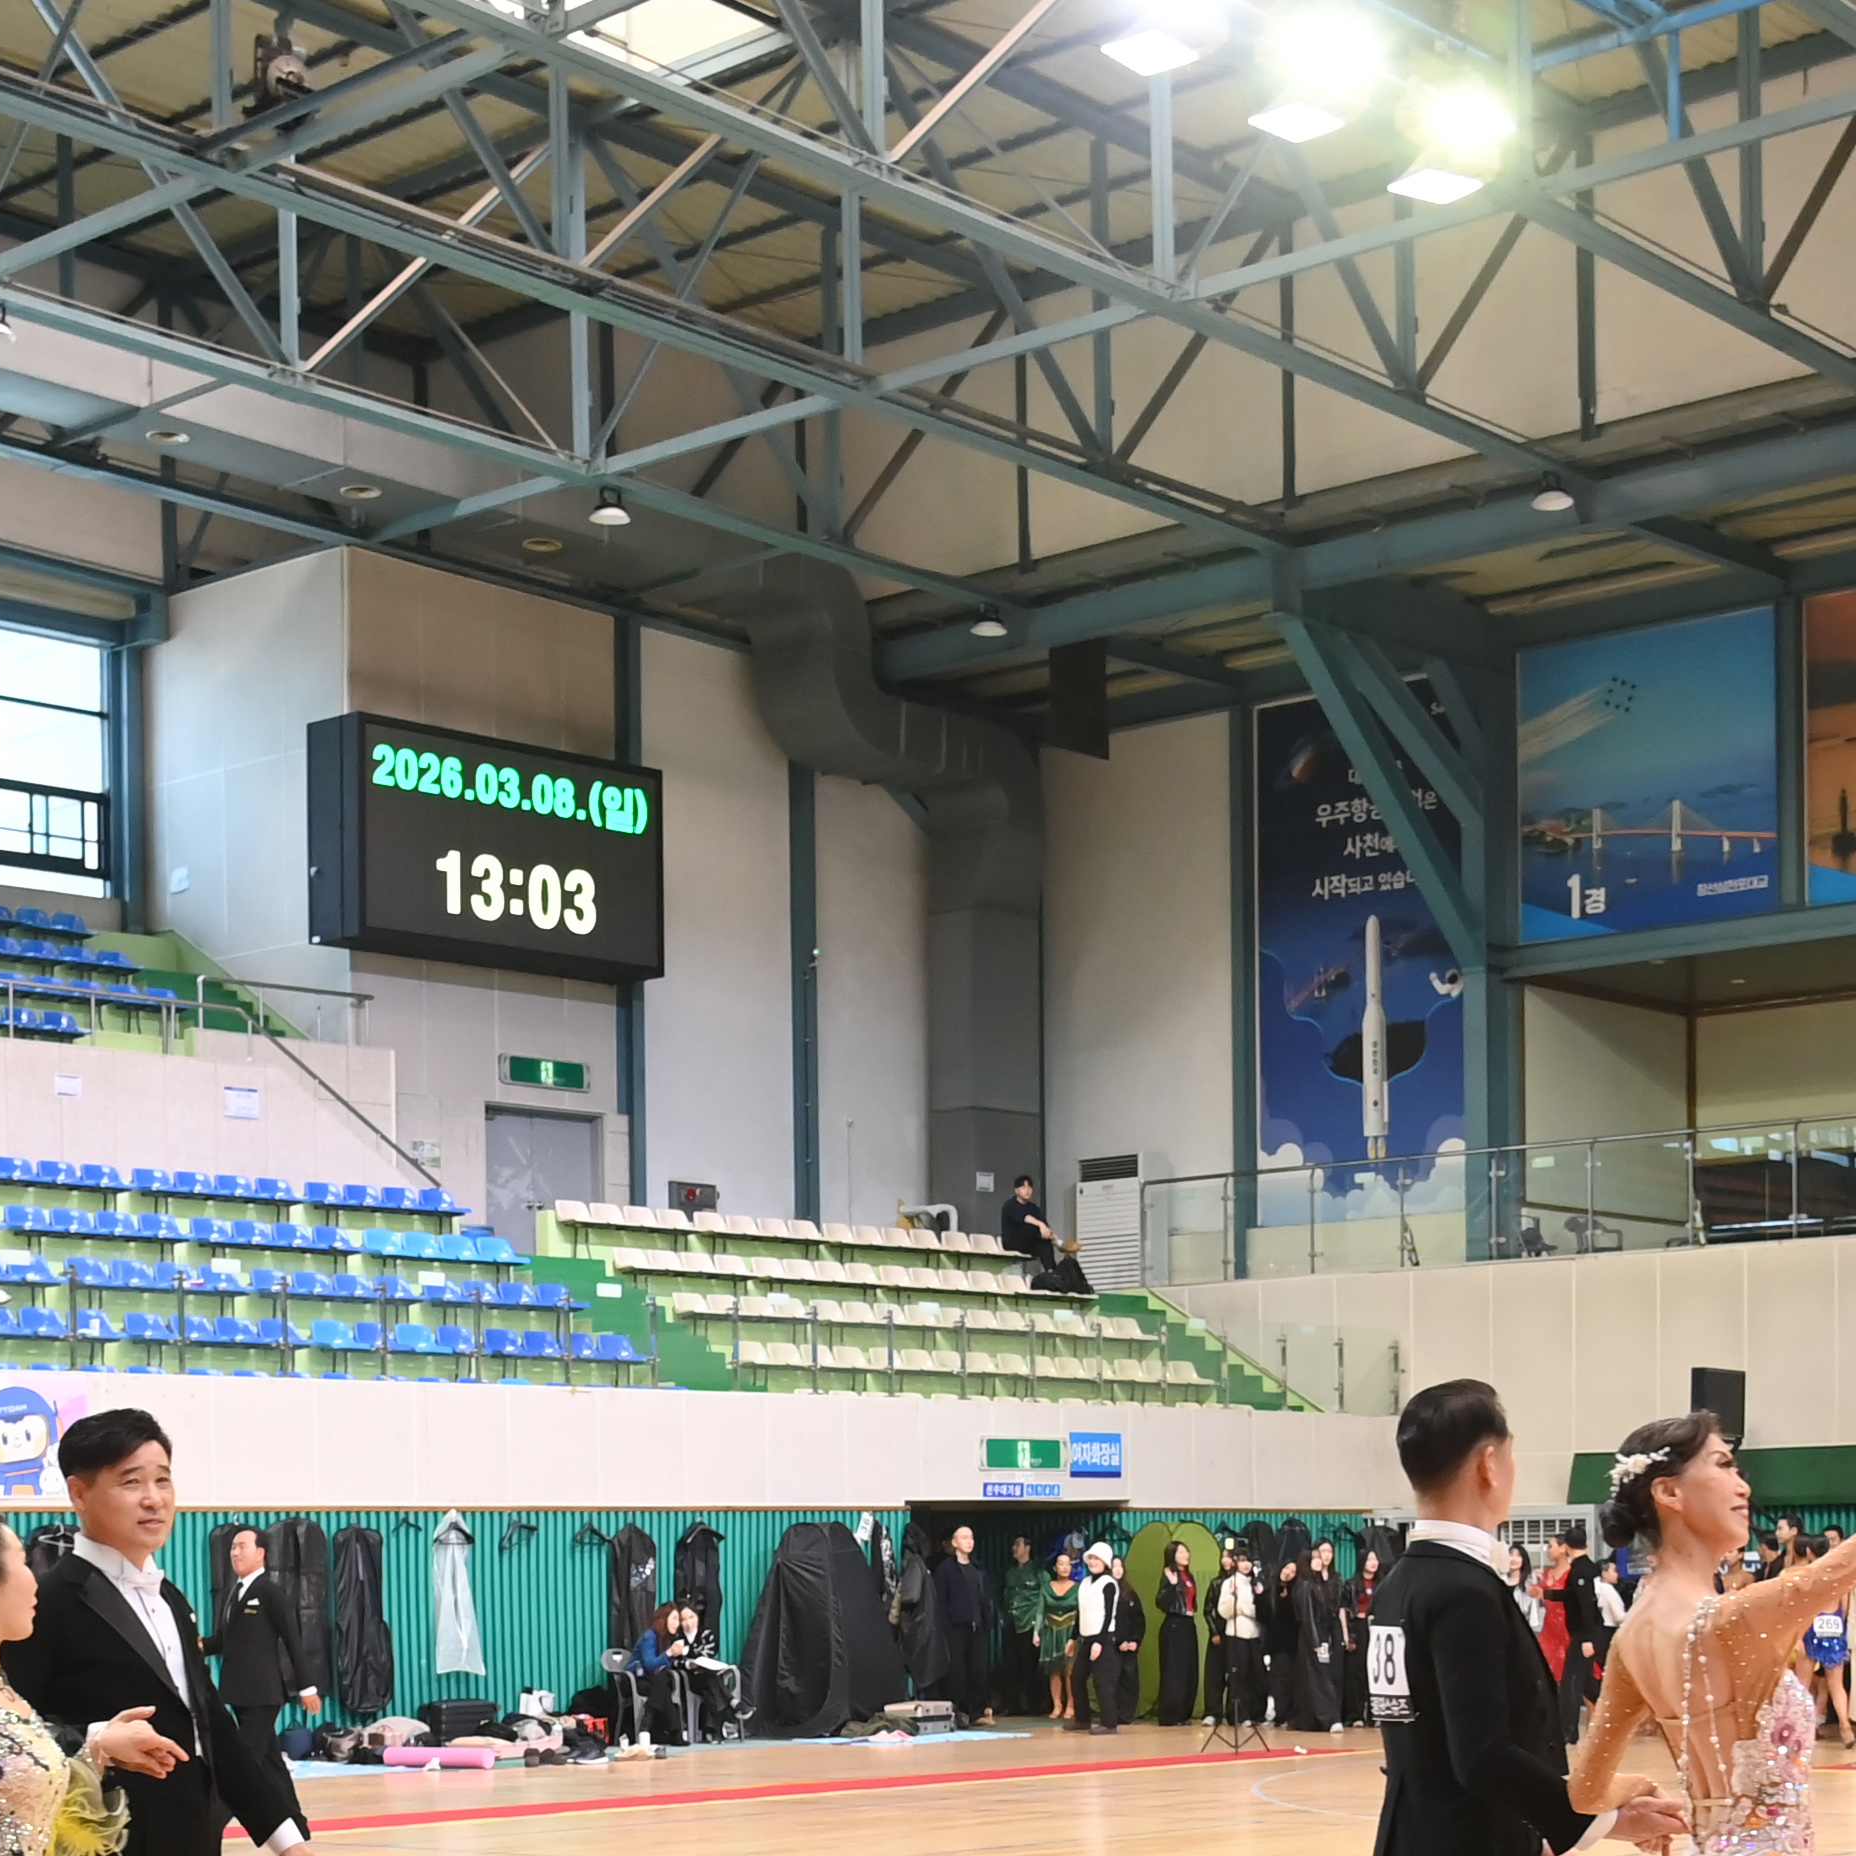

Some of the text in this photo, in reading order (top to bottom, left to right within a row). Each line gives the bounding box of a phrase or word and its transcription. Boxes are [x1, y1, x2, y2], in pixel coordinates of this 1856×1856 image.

[372, 743, 649, 835] 2026.03.08.(일)
[436, 849, 597, 935] 13:03
[1312, 873, 1375, 900] 시작되고
[1567, 873, 1607, 919] 1경
[1072, 1442, 1120, 1466] 여자화장실
[1818, 1618, 1840, 1630] 269
[1372, 1632, 1396, 1686] 38
